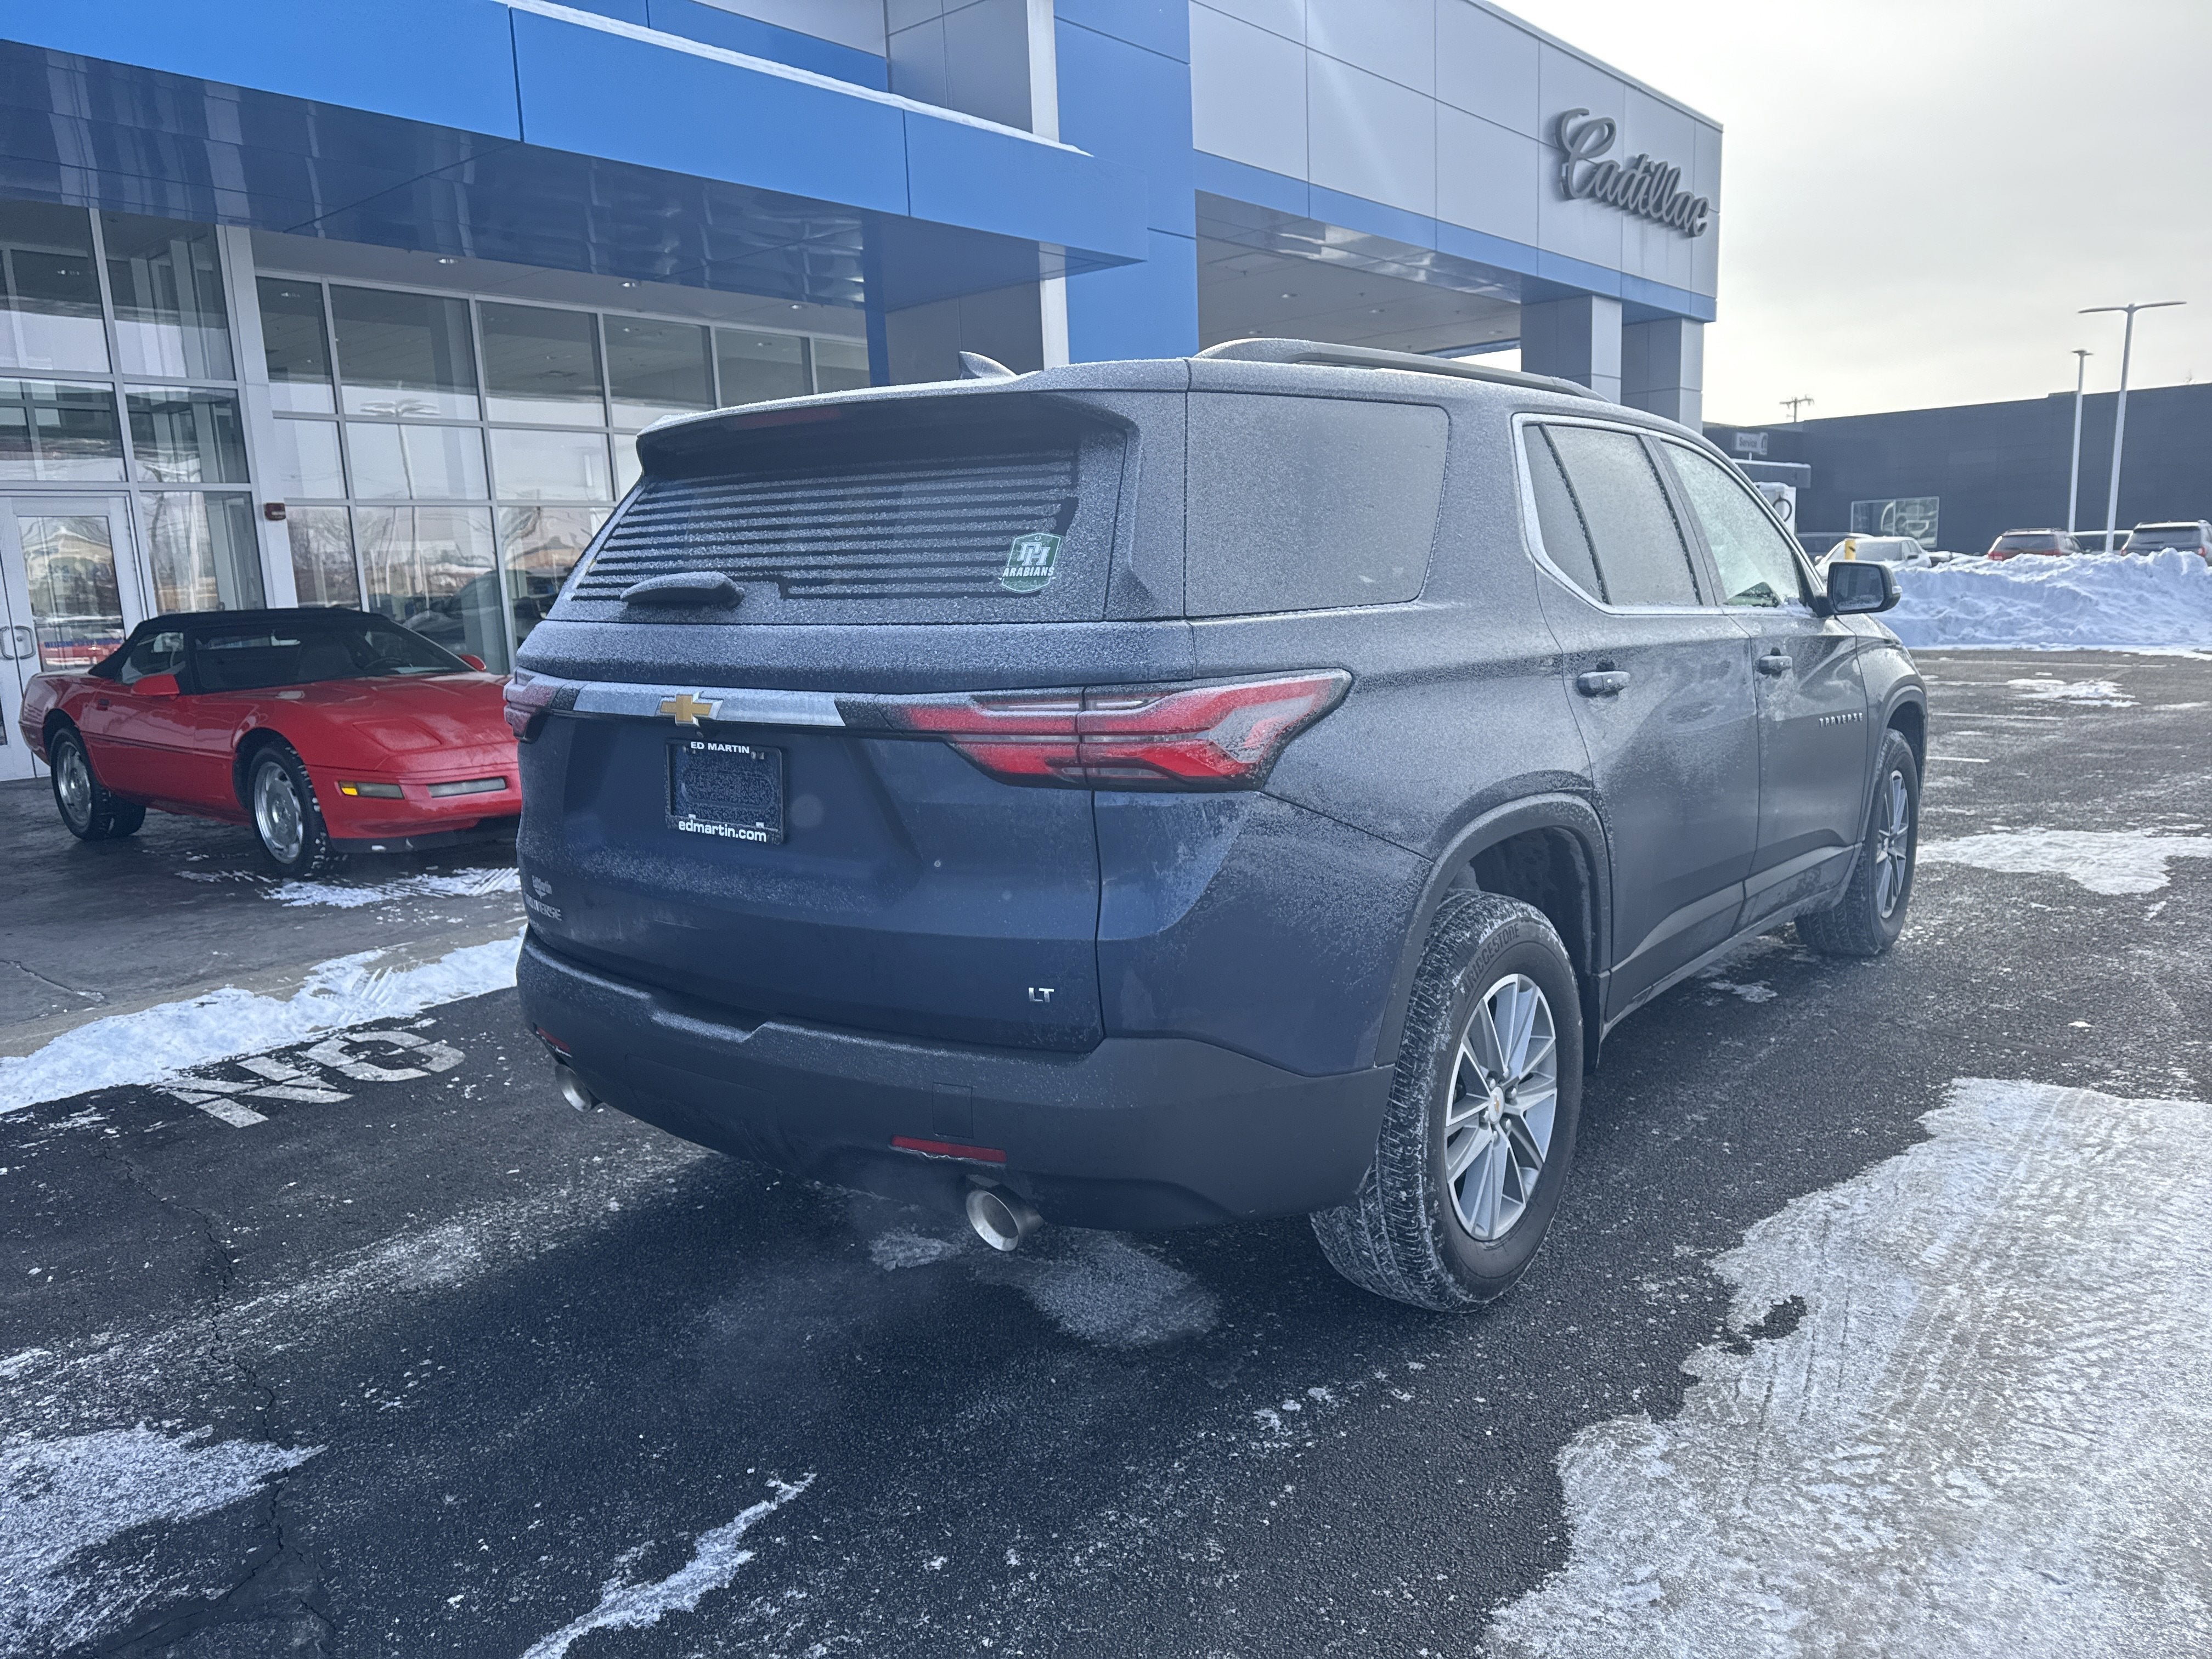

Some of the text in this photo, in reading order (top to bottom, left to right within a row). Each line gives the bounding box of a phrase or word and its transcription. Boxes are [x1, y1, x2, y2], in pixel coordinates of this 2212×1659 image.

[1555, 108, 1708, 236] Cadillac
[1002, 567, 1054, 577] ARABIANS
[1819, 713, 1863, 727] TRAVERSE
[690, 741, 749, 753] ED MARTIN
[678, 820, 766, 842] edmartin.com
[1029, 988, 1054, 1002] LT
